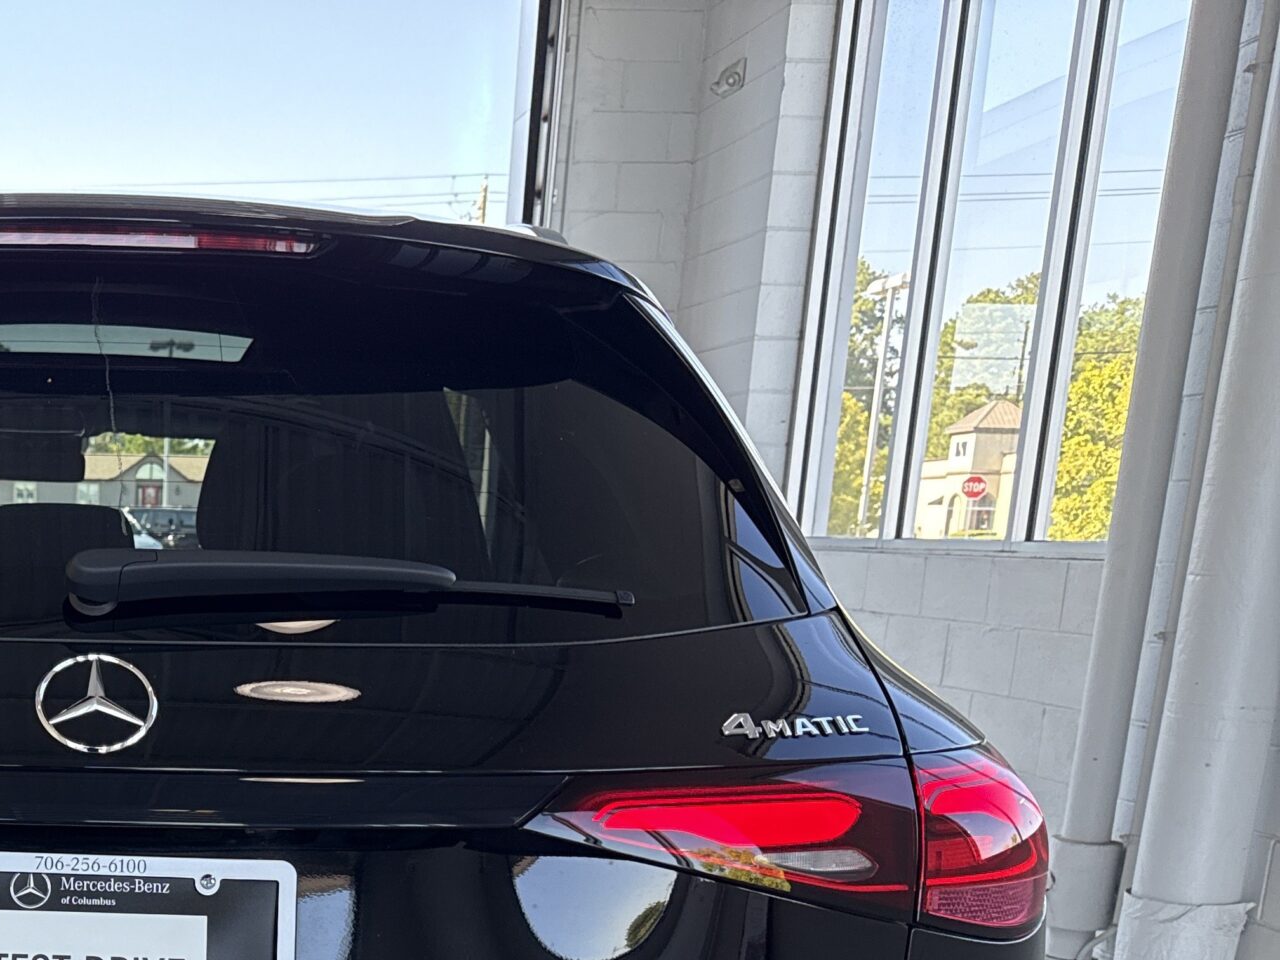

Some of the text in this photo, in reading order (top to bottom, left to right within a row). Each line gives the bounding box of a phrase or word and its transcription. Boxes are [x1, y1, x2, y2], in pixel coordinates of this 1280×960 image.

[963, 481, 986, 493] STOP
[722, 712, 870, 740] 4MATIC
[34, 855, 147, 874] 706-256-6100
[60, 876, 171, 894] Mercedes-Benz
[61, 895, 116, 906] of Columbus
